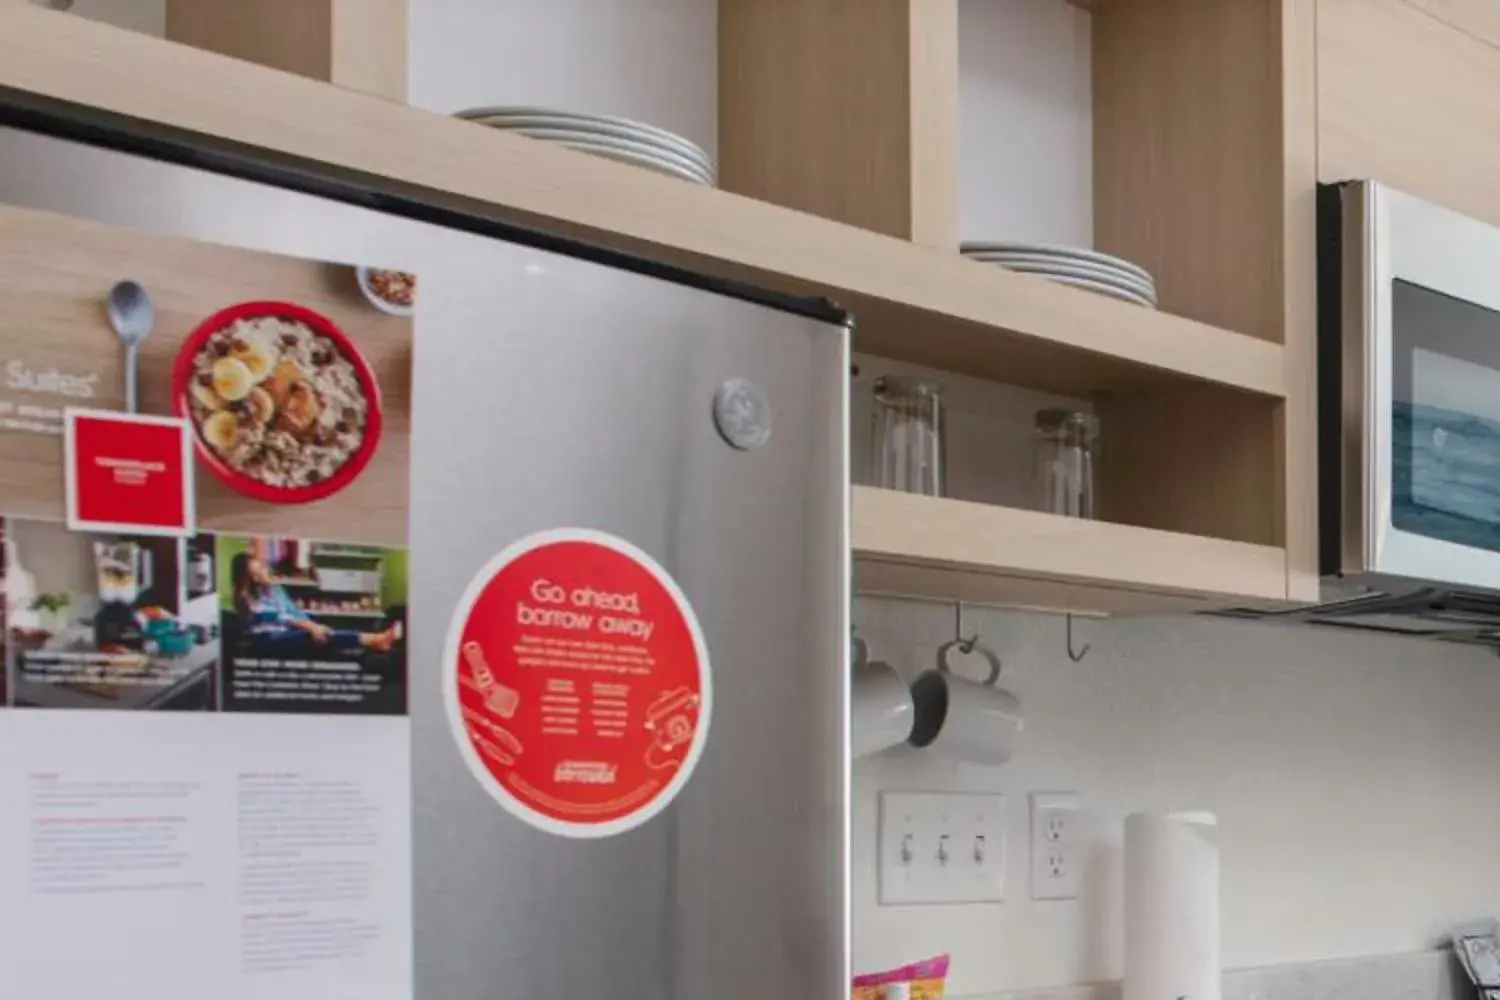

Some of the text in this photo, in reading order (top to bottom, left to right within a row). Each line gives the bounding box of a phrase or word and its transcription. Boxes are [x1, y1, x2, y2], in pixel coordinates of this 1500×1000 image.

[530, 577, 566, 603] Go
[516, 601, 654, 642] borrow away
